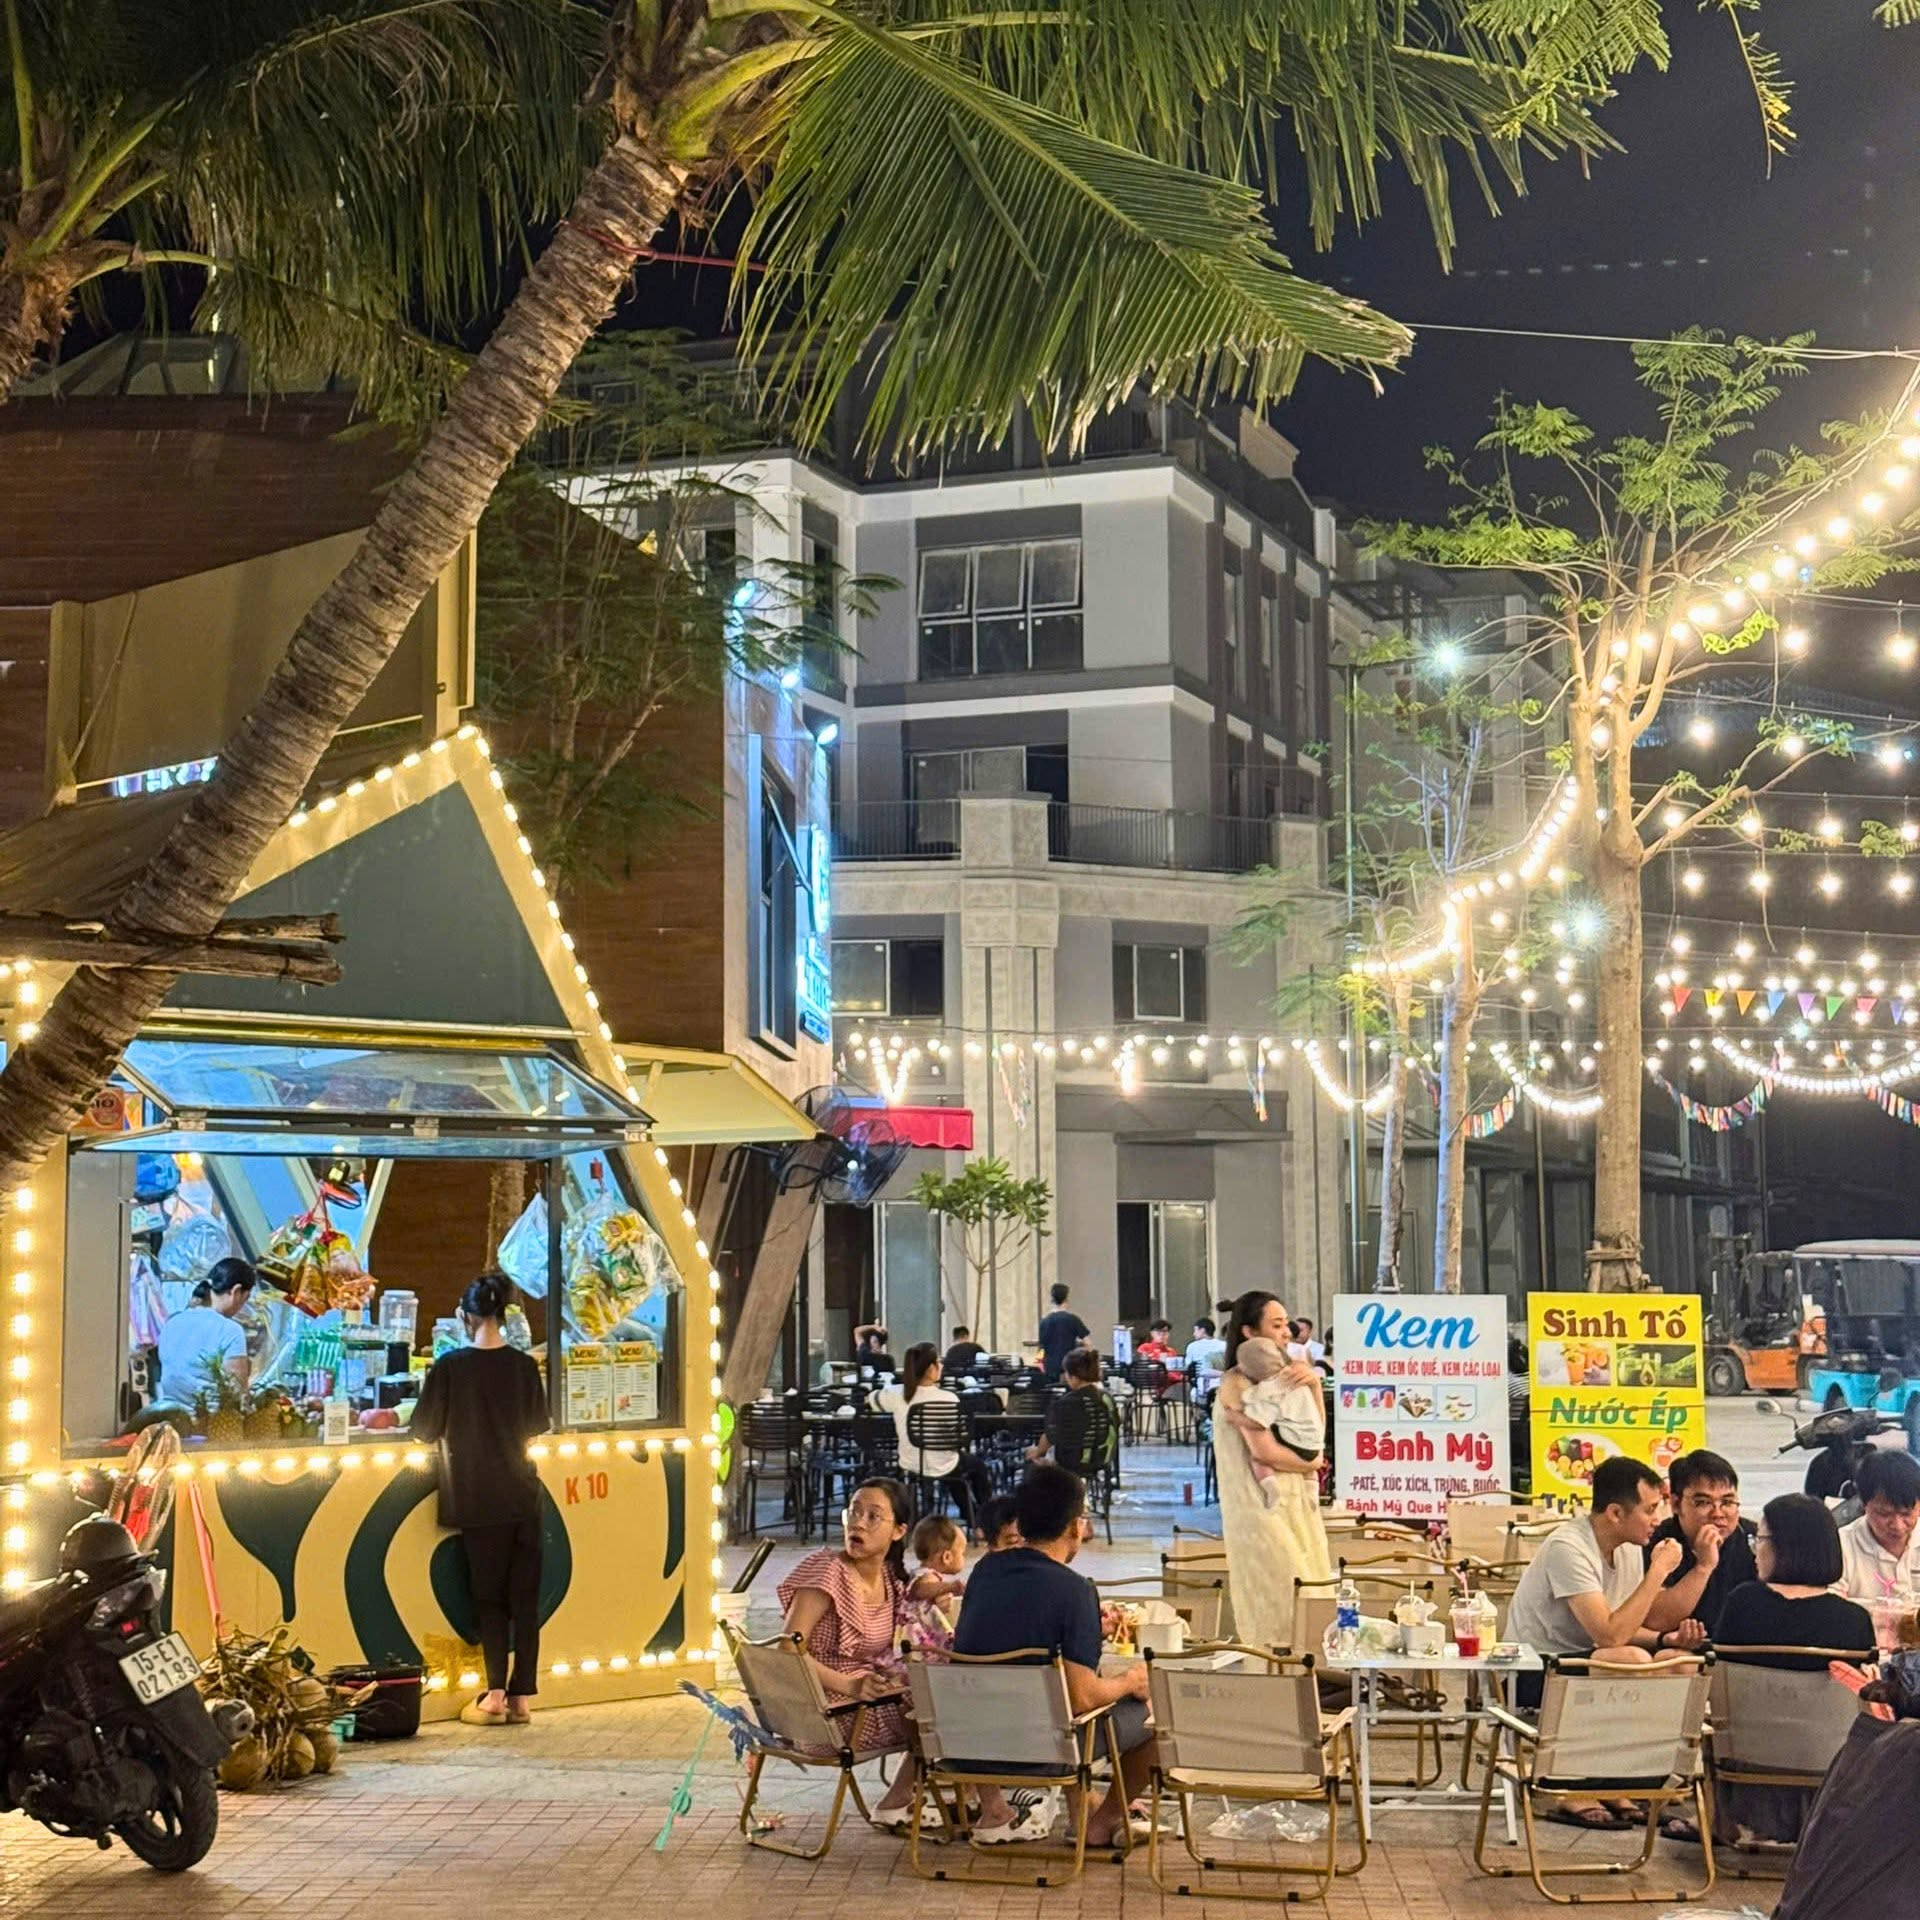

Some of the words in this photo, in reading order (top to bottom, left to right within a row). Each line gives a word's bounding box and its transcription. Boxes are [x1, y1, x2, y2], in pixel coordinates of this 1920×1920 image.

[1357, 1302, 1480, 1349] Kem
[1543, 1308, 1628, 1338] Sinh
[1639, 1304, 1688, 1338] Tố
[1387, 1360, 1405, 1375] KEM
[1442, 1361, 1461, 1376] KEM
[1549, 1396, 1639, 1425] Nước
[1650, 1391, 1688, 1433] Ép
[1356, 1430, 1434, 1461] Bánh
[1446, 1432, 1493, 1471] Mỳ
[565, 1476, 580, 1504] K
[586, 1472, 608, 1500] 10
[1382, 1474, 1402, 1491] XÚC
[1346, 1499, 1378, 1512] Bánh
[1407, 1500, 1432, 1514] Que
[131, 1639, 180, 1675] 15-E1
[137, 1656, 198, 1699] 021.93
